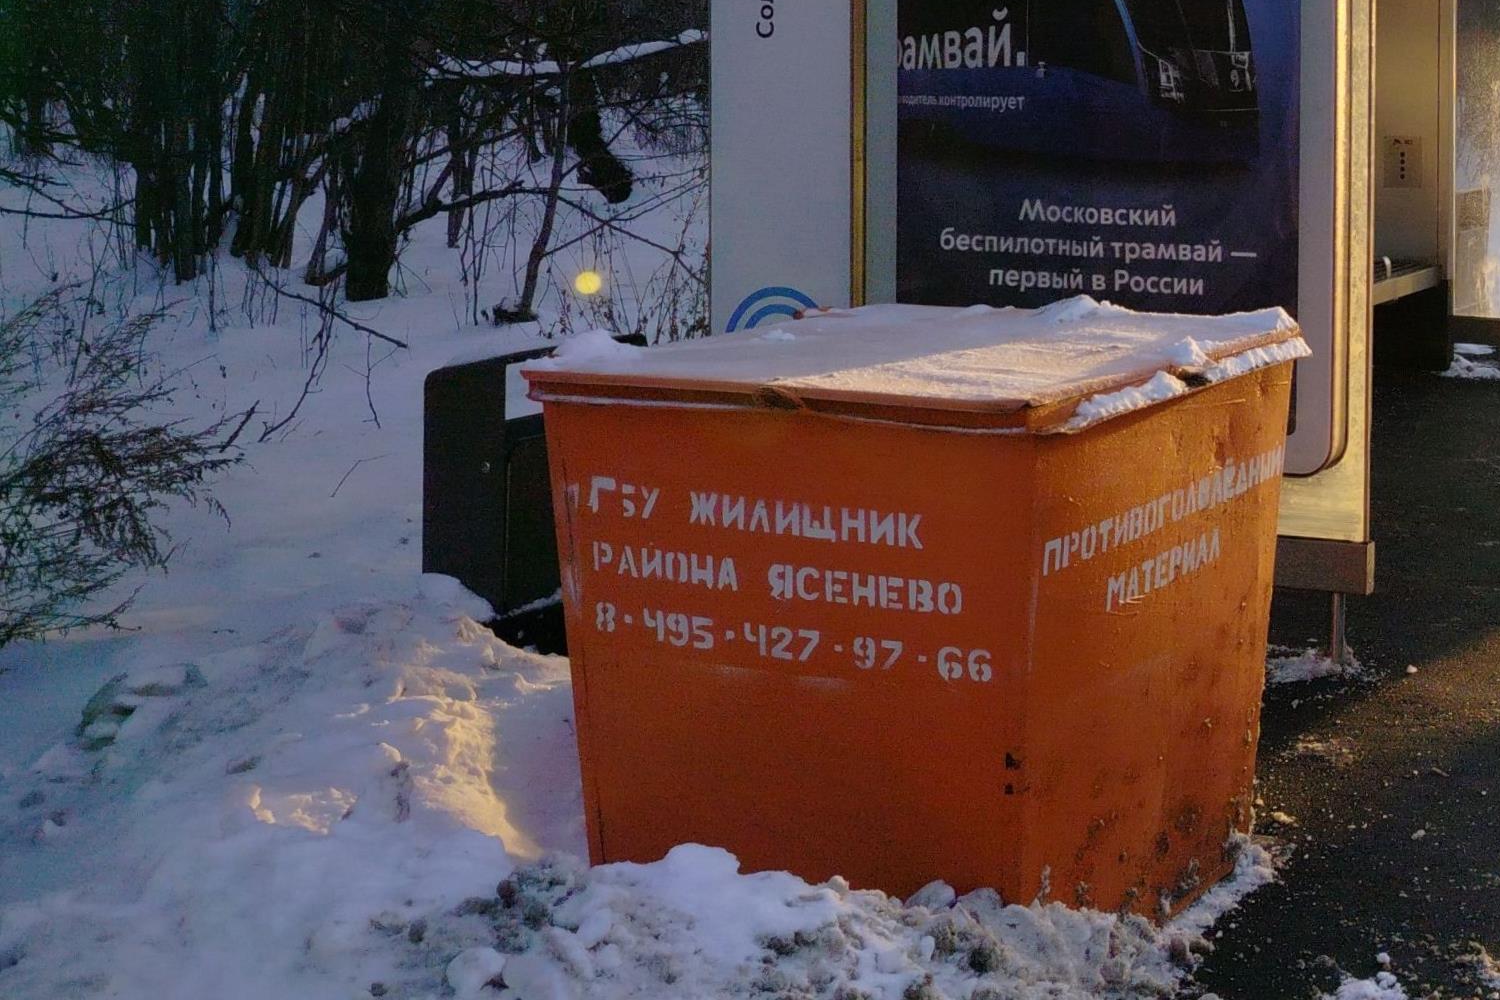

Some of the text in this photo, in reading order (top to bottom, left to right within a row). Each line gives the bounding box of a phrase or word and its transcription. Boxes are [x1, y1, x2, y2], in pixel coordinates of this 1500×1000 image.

[938, 94, 1025, 113] контролирует
[1018, 198, 1177, 228] Московский
[940, 227, 1104, 259] беспилотный
[1111, 234, 1223, 263] трамвай
[989, 267, 1205, 297] первый в России
[587, 475, 924, 551] ГБУ ЖИЛИЩНИК
[1106, 526, 1223, 614] МАТЕРИАЛ
[767, 563, 964, 616] ЯСЕНЕВО
